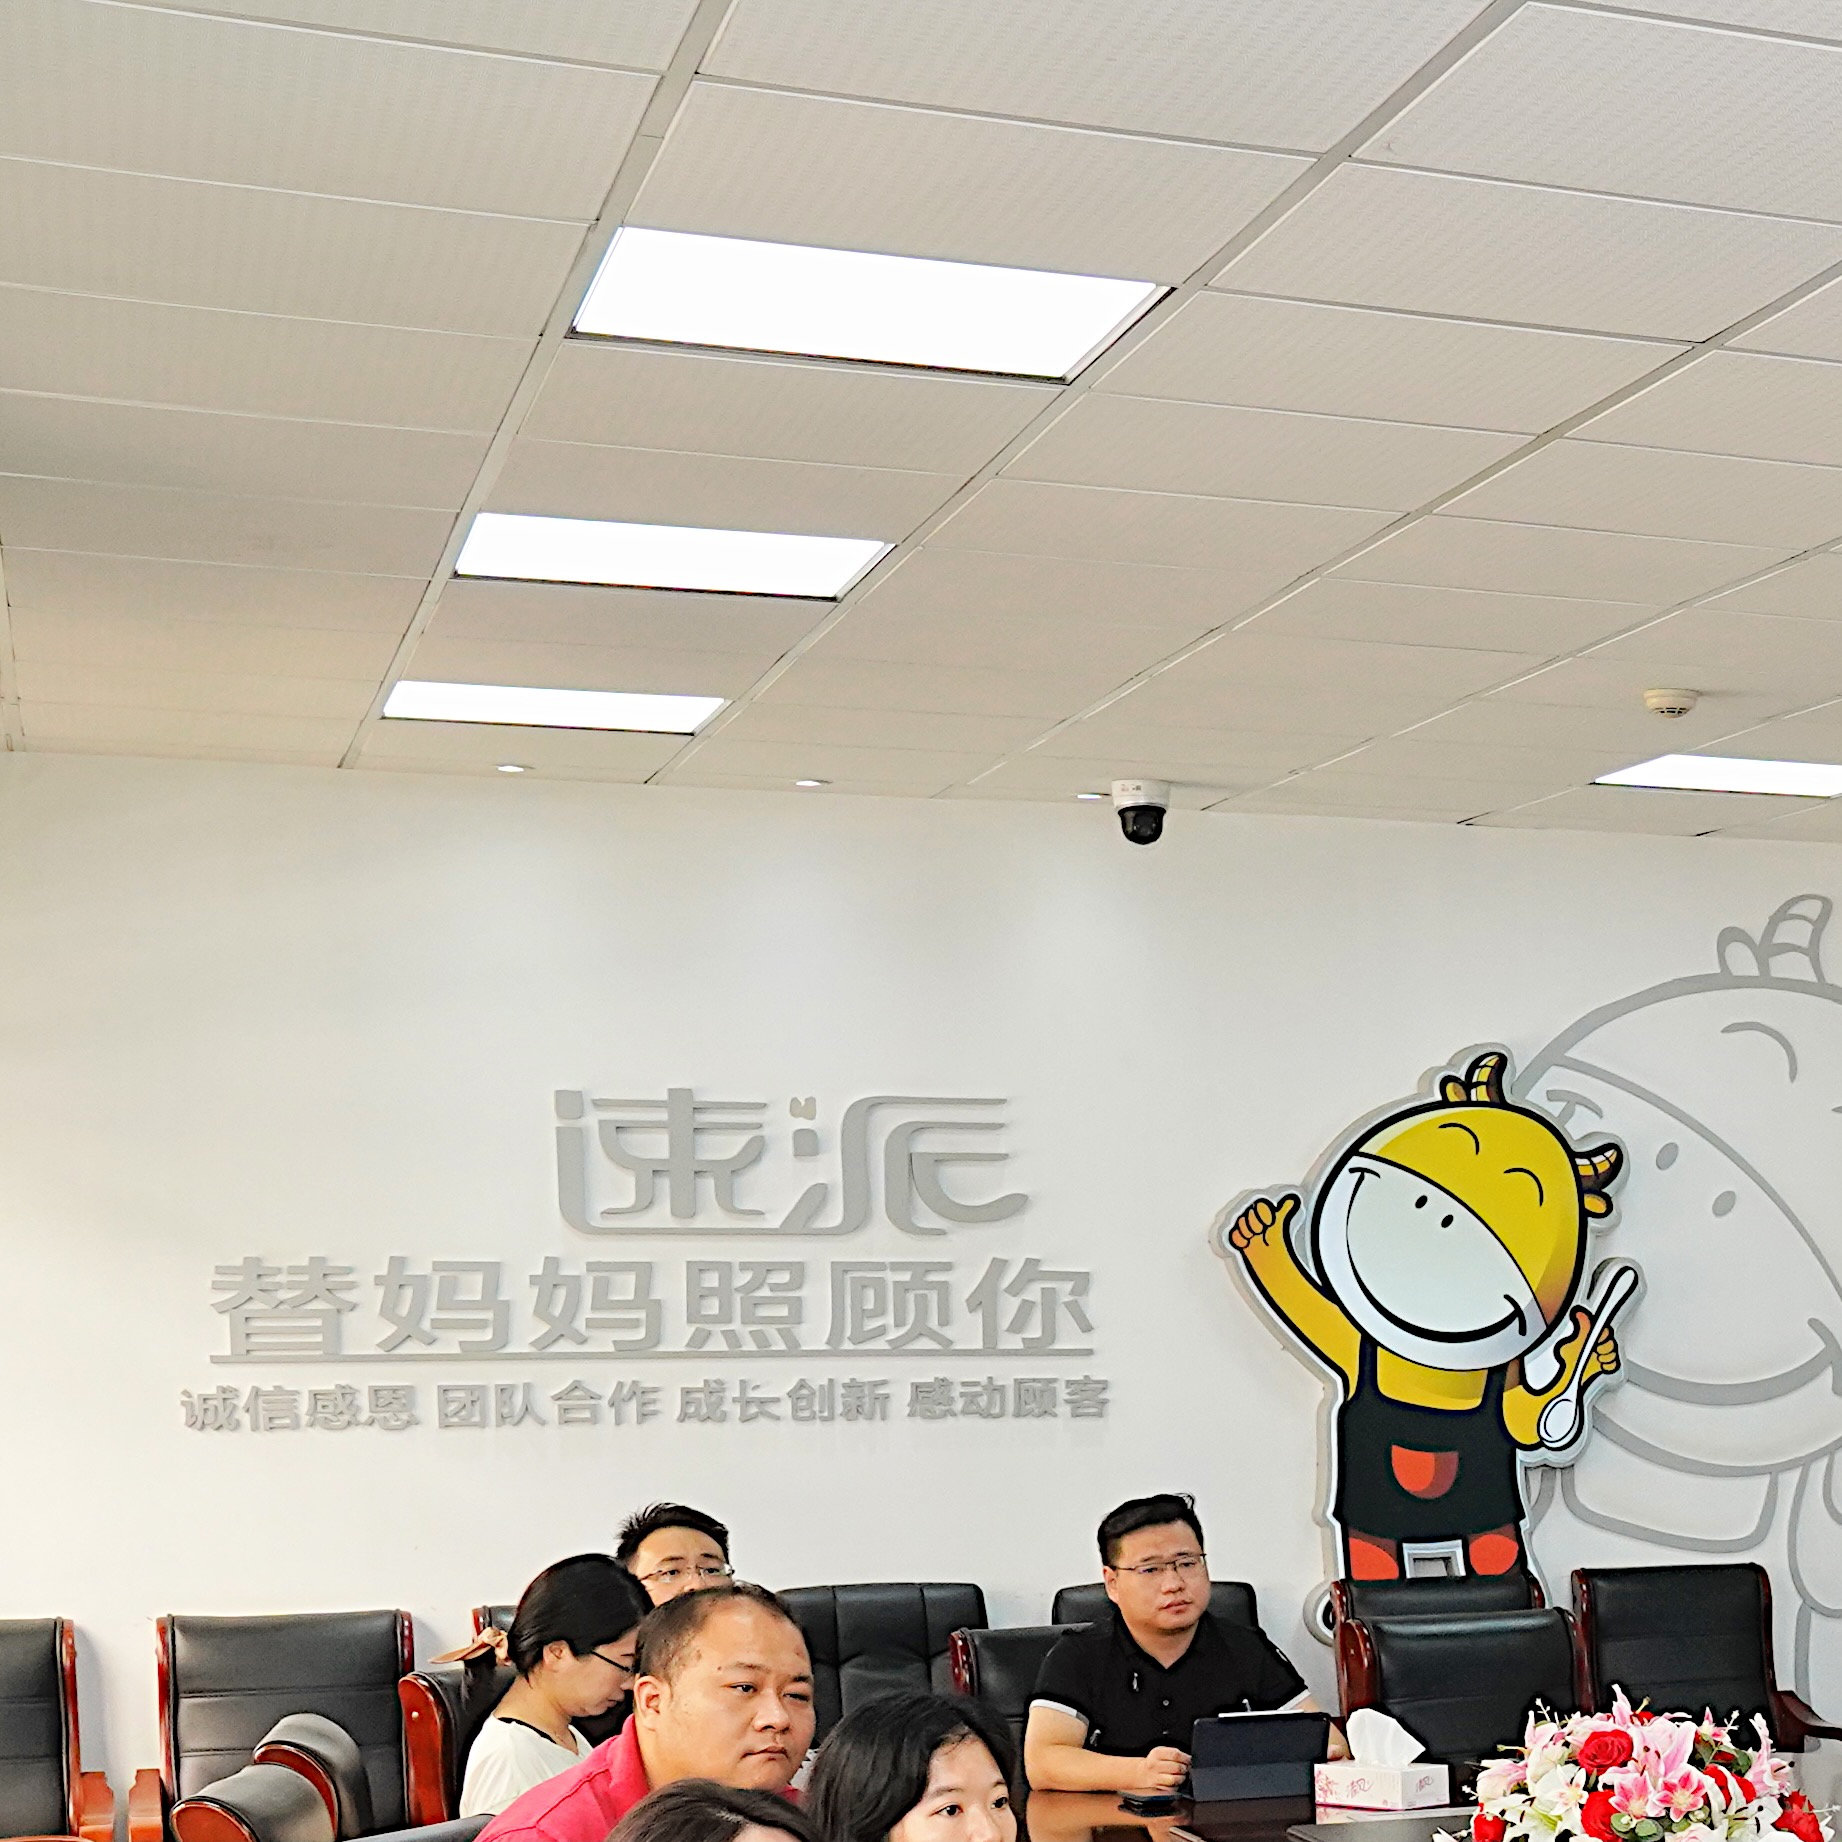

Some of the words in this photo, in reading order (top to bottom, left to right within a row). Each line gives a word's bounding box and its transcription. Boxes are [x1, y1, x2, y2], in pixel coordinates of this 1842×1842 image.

[553, 1087, 1030, 1236] 速派
[209, 1255, 1095, 1354] 替妈妈照顾你
[180, 1384, 420, 1433] 诚信感恩
[436, 1379, 662, 1429] 团队合作
[676, 1377, 890, 1423] 成长创新
[906, 1374, 1110, 1420] 感动顾客
